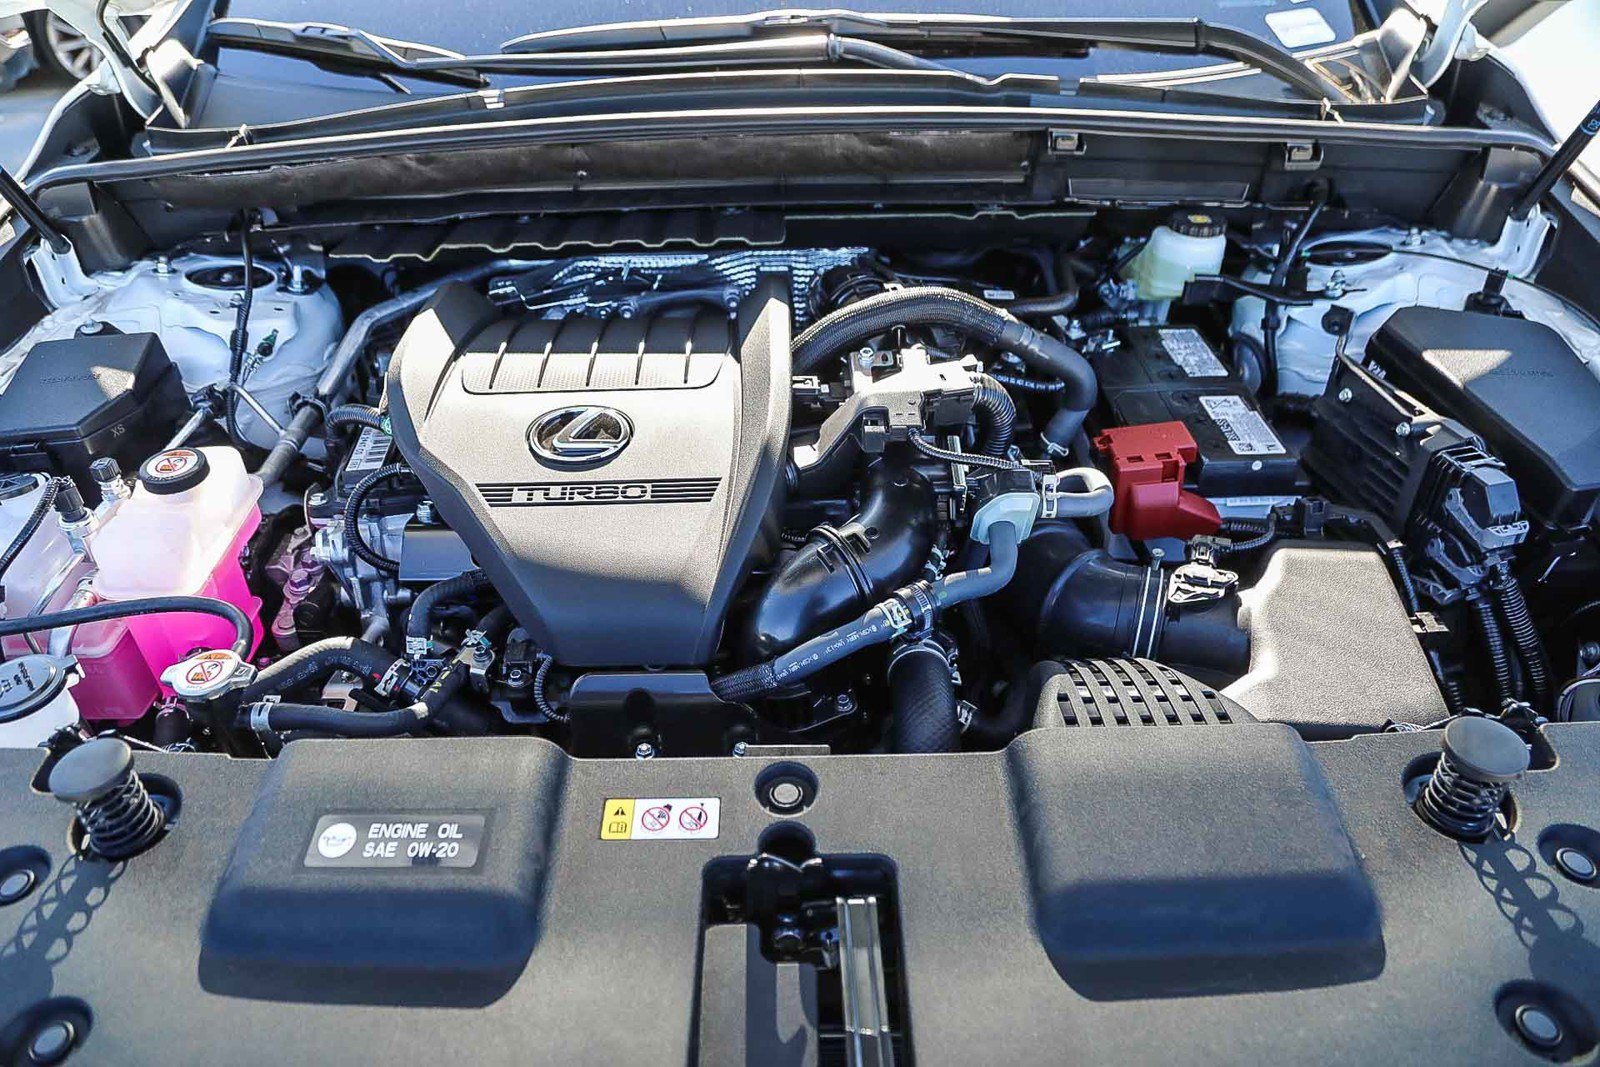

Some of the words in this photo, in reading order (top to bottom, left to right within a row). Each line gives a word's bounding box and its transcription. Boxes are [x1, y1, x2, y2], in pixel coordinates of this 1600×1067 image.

[513, 483, 650, 502] TURBO
[368, 823, 429, 839] ENGINE
[437, 823, 463, 839] OIL
[362, 841, 398, 858] SAE
